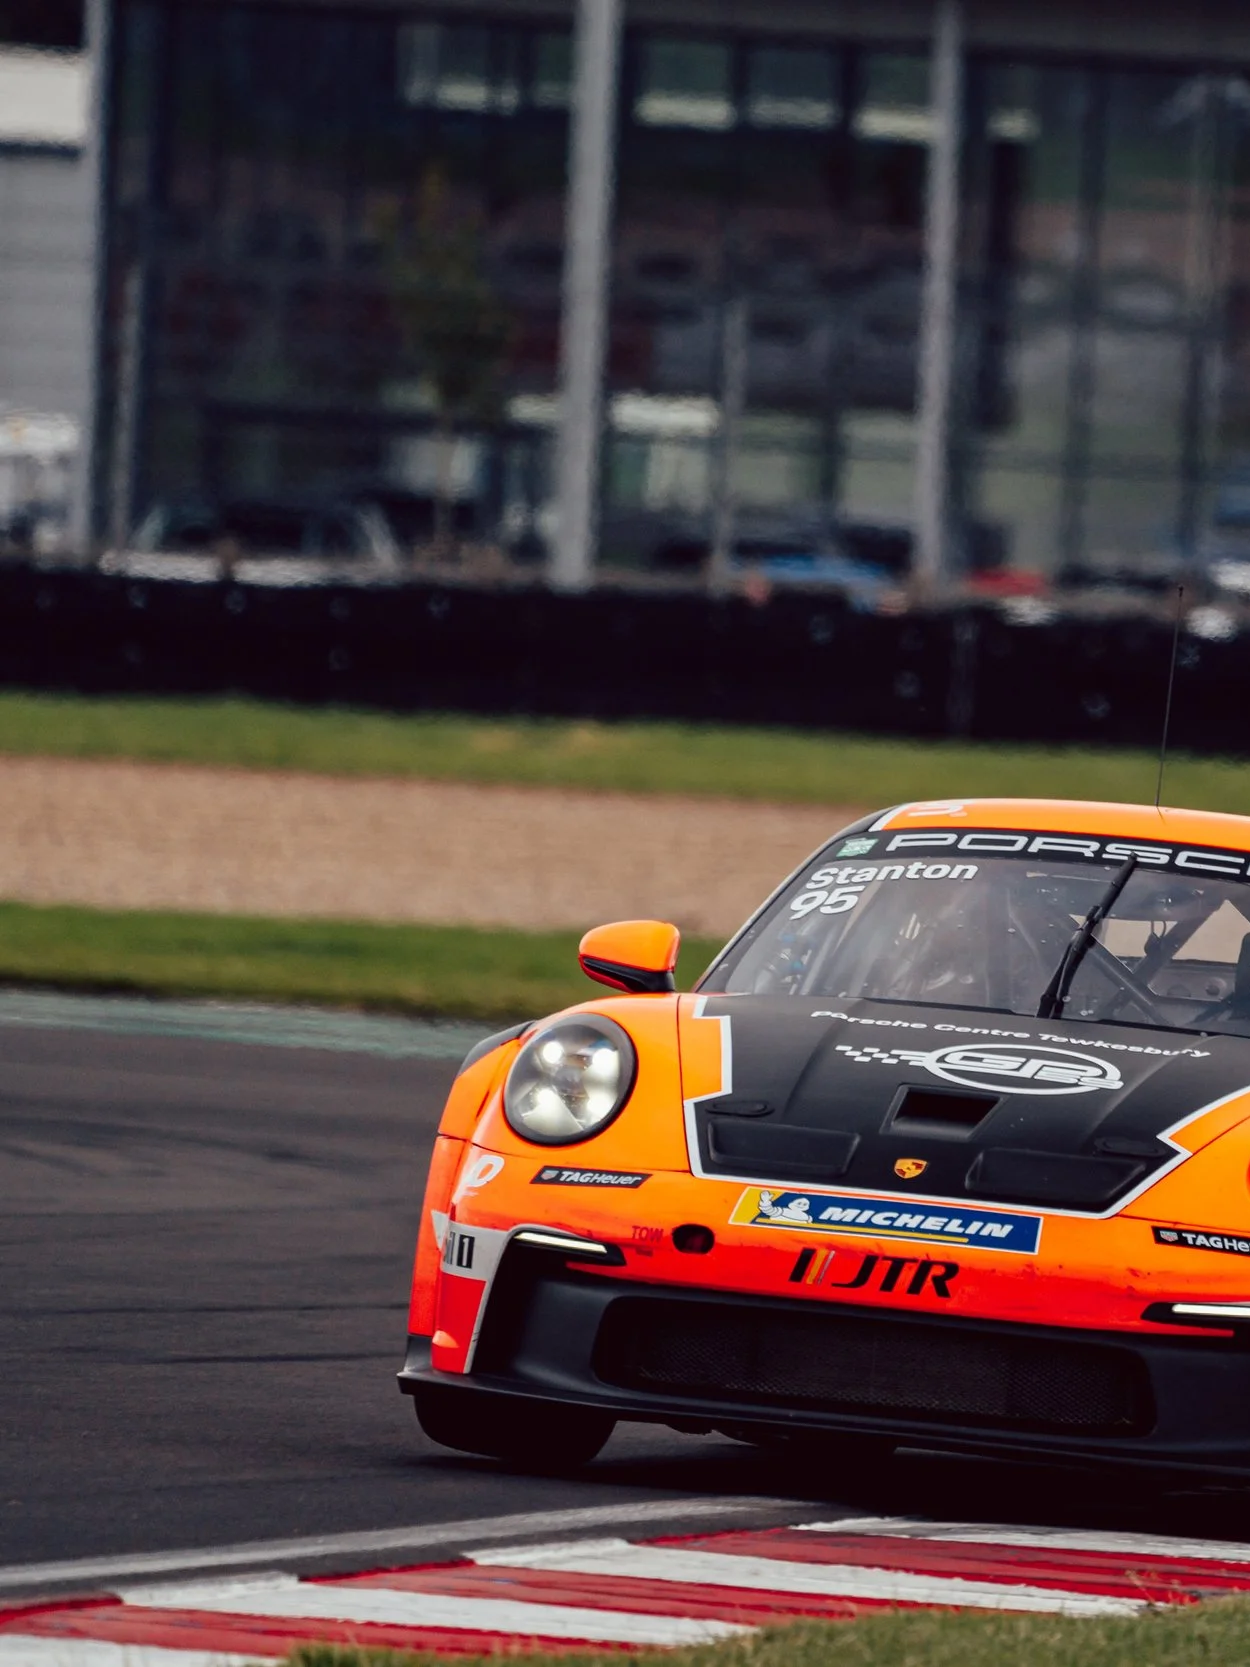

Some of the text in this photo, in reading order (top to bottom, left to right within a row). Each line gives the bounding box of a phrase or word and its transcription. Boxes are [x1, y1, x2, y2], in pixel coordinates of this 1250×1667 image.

[806, 862, 979, 889] Stanton
[789, 885, 866, 920] 95
[811, 1010, 1211, 1058] Porsche Centre Tewkesbury
[632, 1225, 664, 1243] TOW
[819, 1206, 1014, 1239] MICHELIN
[831, 1254, 960, 1299] JTR
